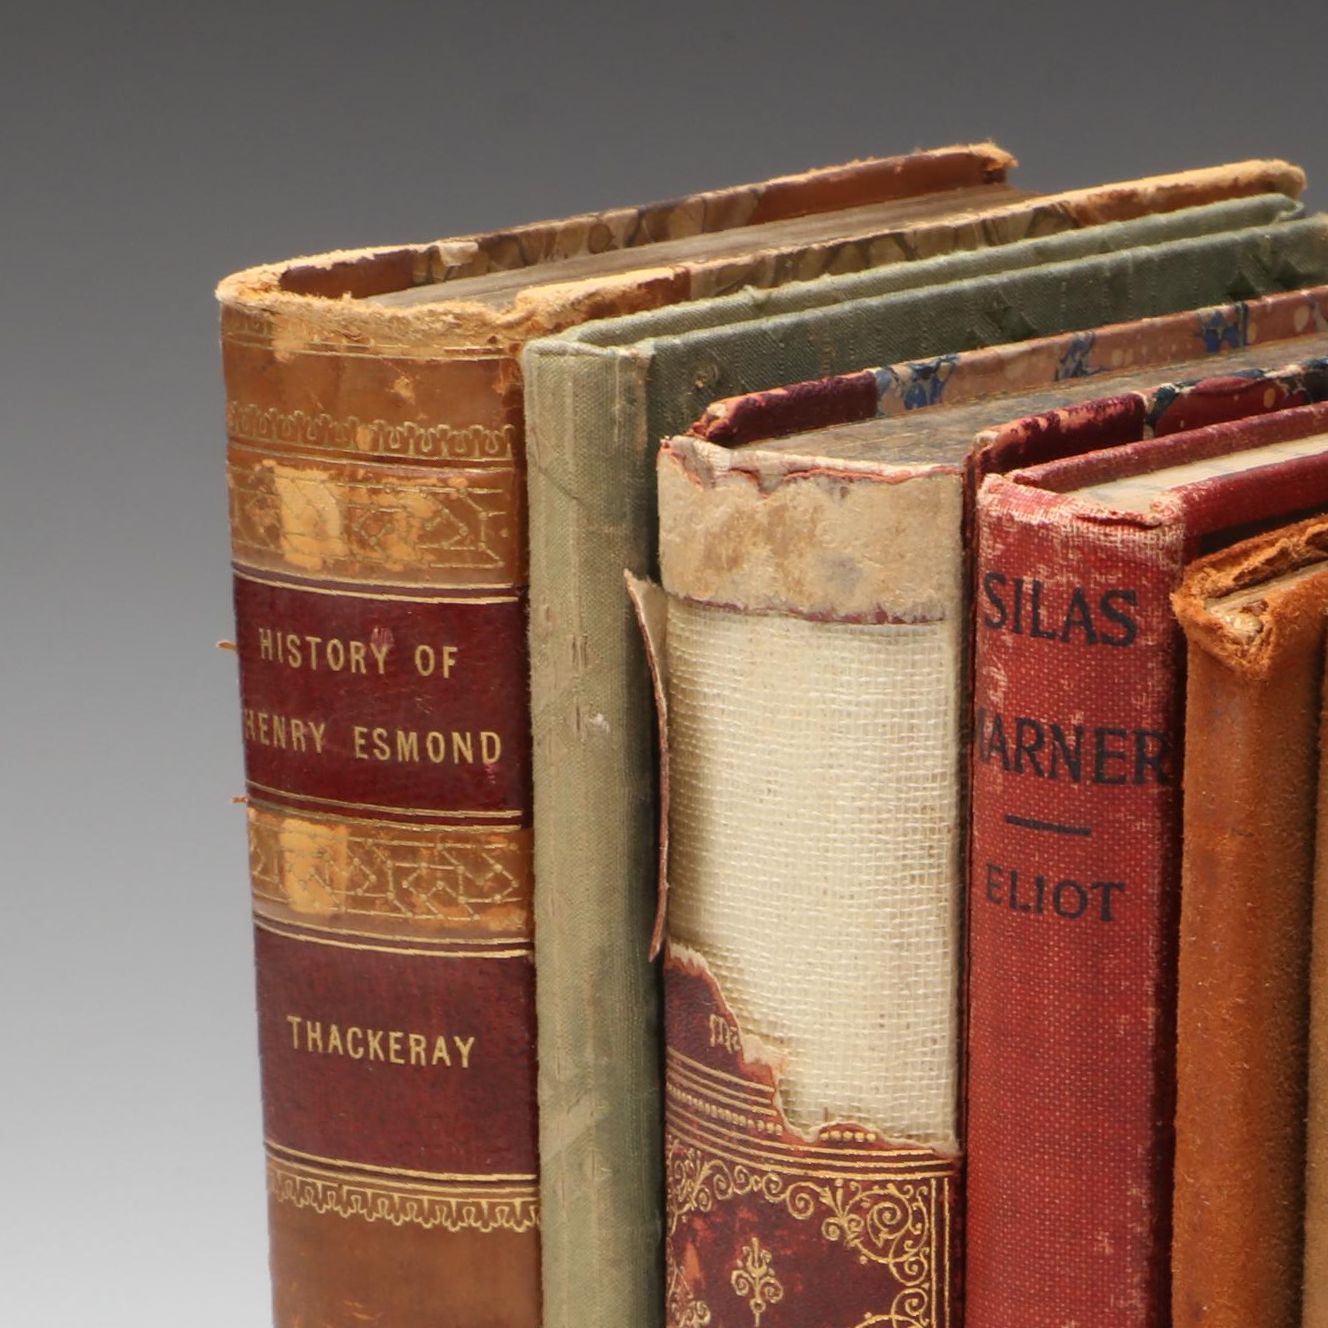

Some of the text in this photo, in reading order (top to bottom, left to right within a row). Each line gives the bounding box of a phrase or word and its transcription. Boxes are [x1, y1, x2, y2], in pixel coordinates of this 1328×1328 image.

[981, 571, 1138, 647] SILAS
[257, 627, 459, 679] HISTORY OF
[353, 725, 503, 765] ESMOND
[985, 862, 1127, 922] ELIOT
[286, 1015, 476, 1069] THACKERAY
